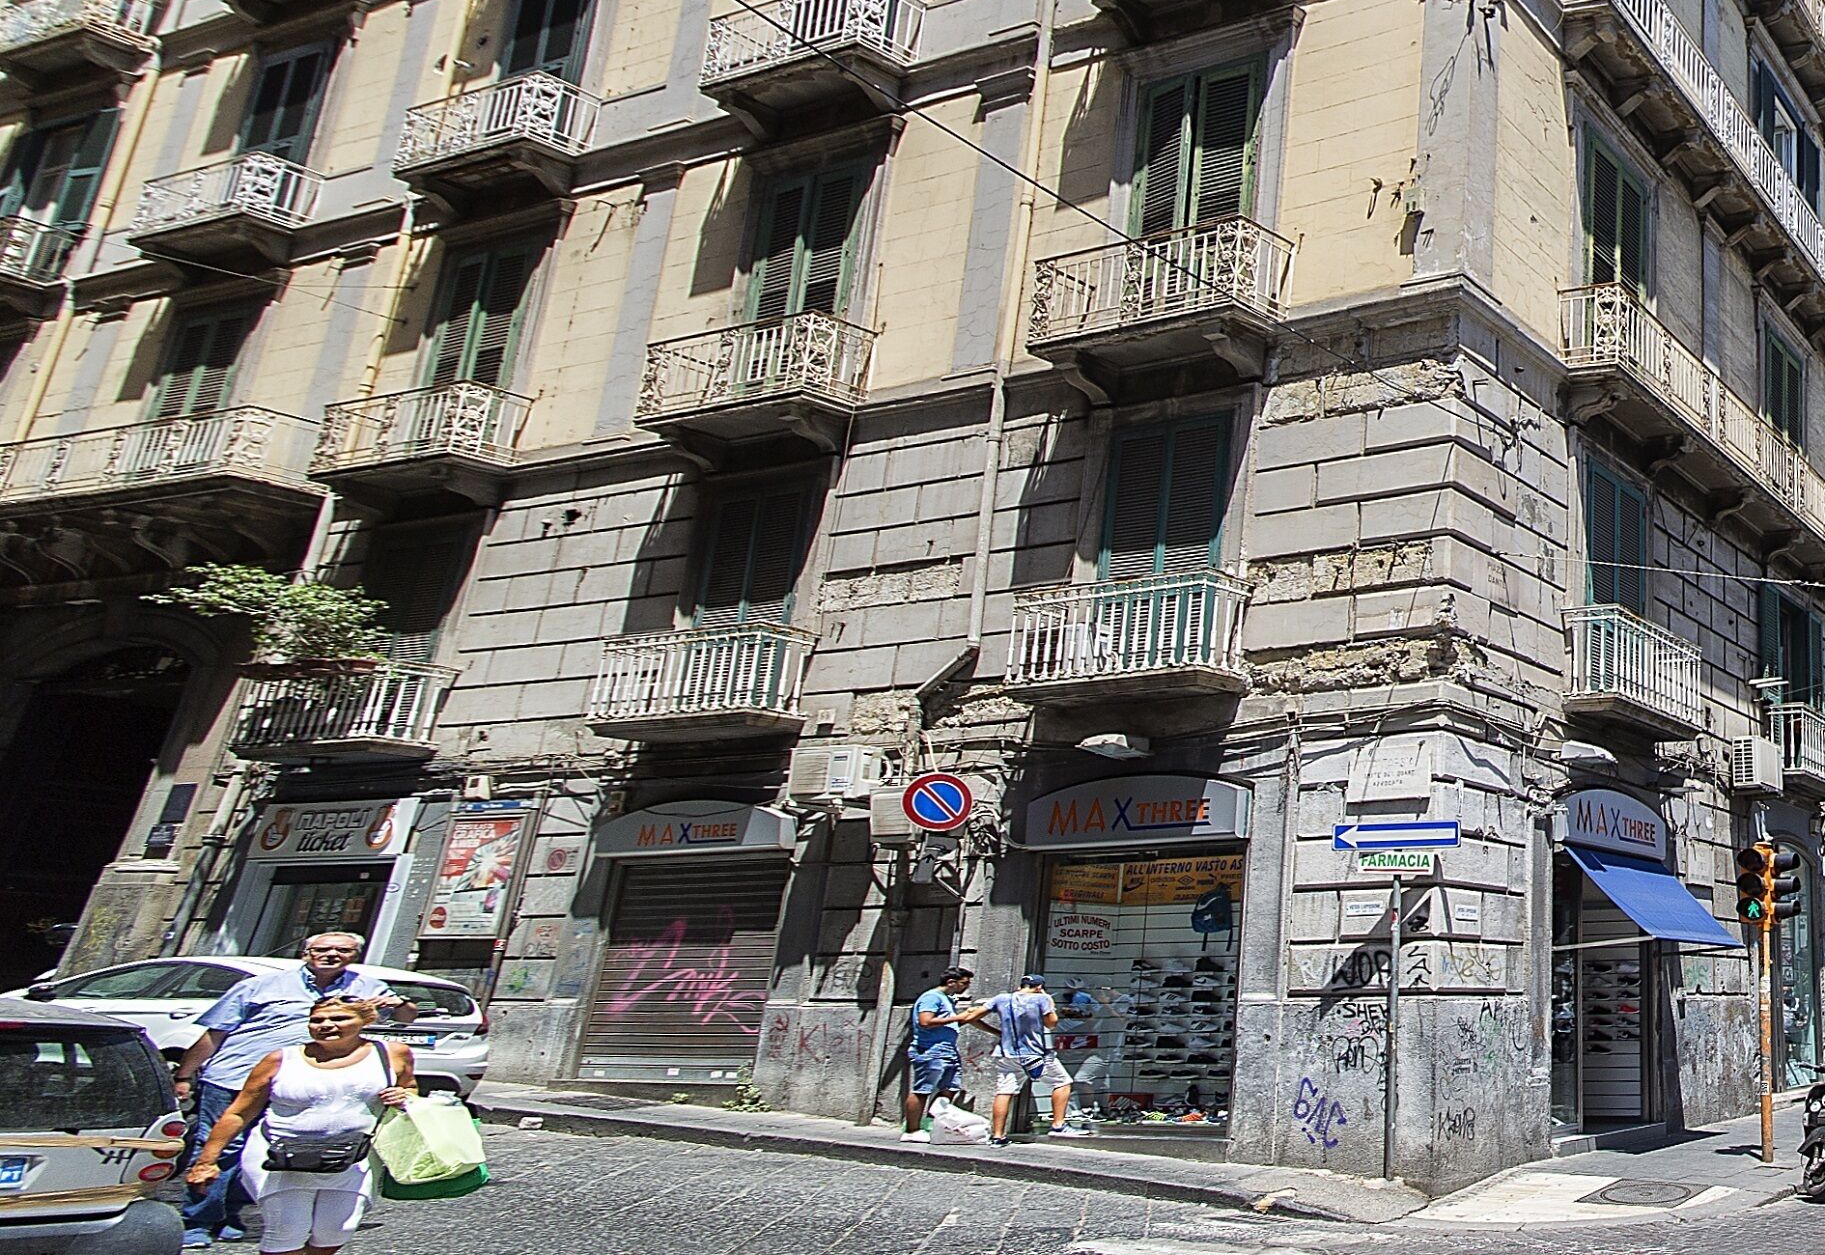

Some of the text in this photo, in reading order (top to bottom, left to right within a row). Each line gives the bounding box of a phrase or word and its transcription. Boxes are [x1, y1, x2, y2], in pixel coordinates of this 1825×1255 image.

[295, 830, 354, 853] ticket
[1125, 860, 1192, 876] ALL'INTERNO
[1194, 859, 1228, 873] VASTO
[1360, 853, 1431, 868] FARMACIA
[1054, 915, 1111, 930] ULTIMI NUMERI
[1059, 929, 1104, 938] SCARPE
[1051, 938, 1110, 950] SOTTO COSTO
